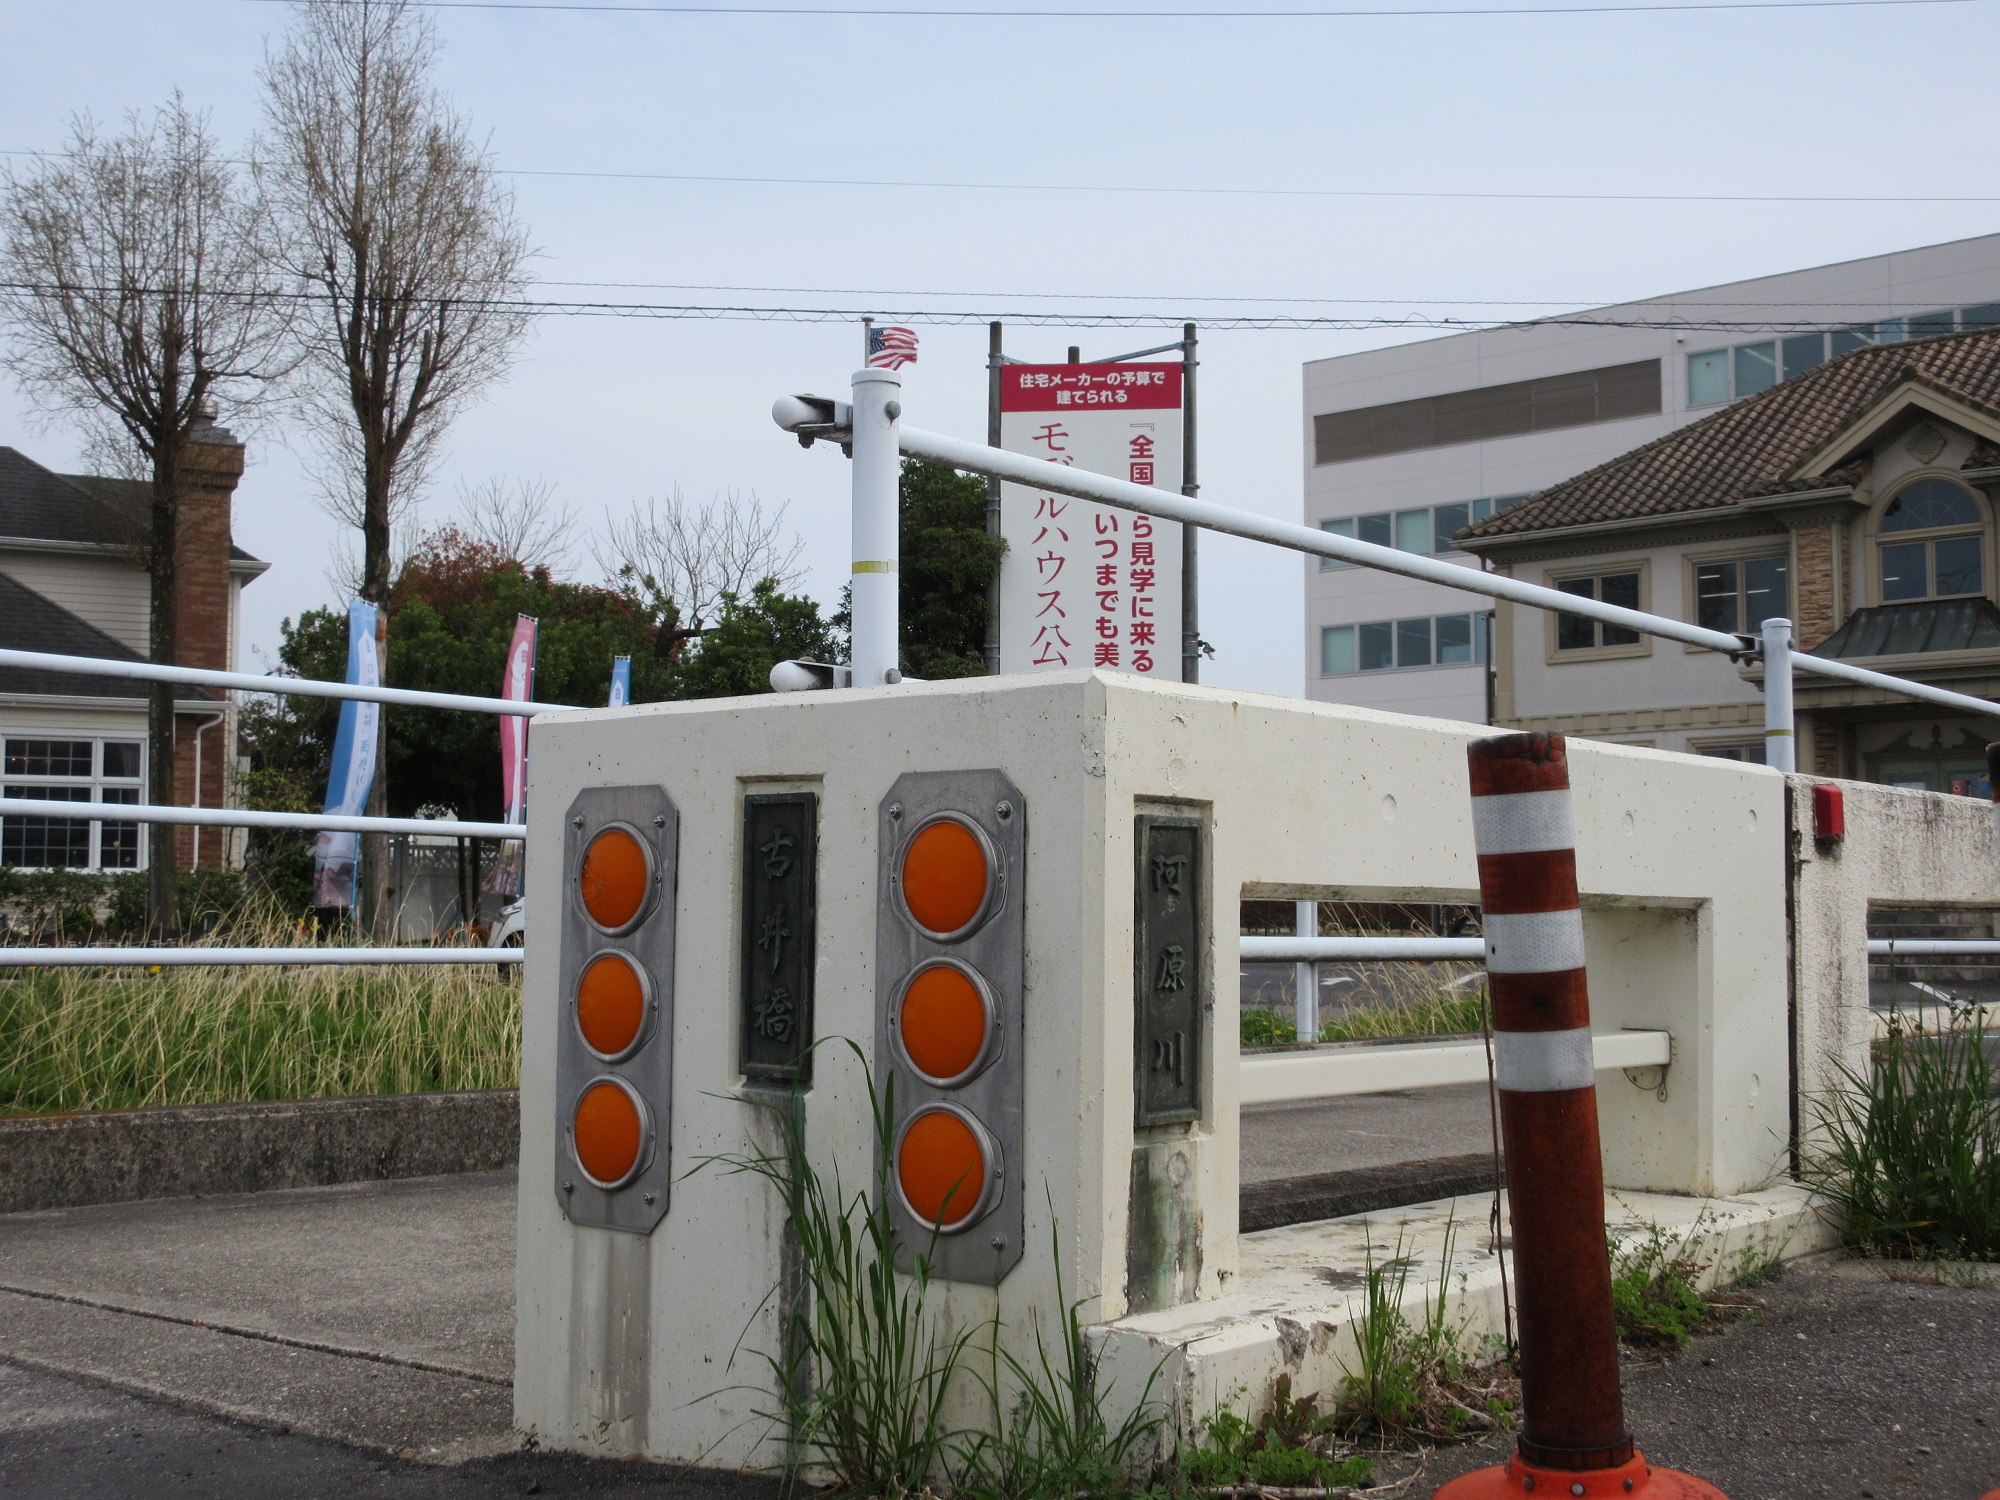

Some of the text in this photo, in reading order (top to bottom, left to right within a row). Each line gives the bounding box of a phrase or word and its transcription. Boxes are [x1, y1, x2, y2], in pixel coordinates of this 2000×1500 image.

[1020, 371, 1165, 388] 住宅メーカーの予算で
[1057, 390, 1127, 404] 建てられる
[1031, 423, 1073, 666] モルハウス公
[1151, 854, 1187, 1087] 阿原川
